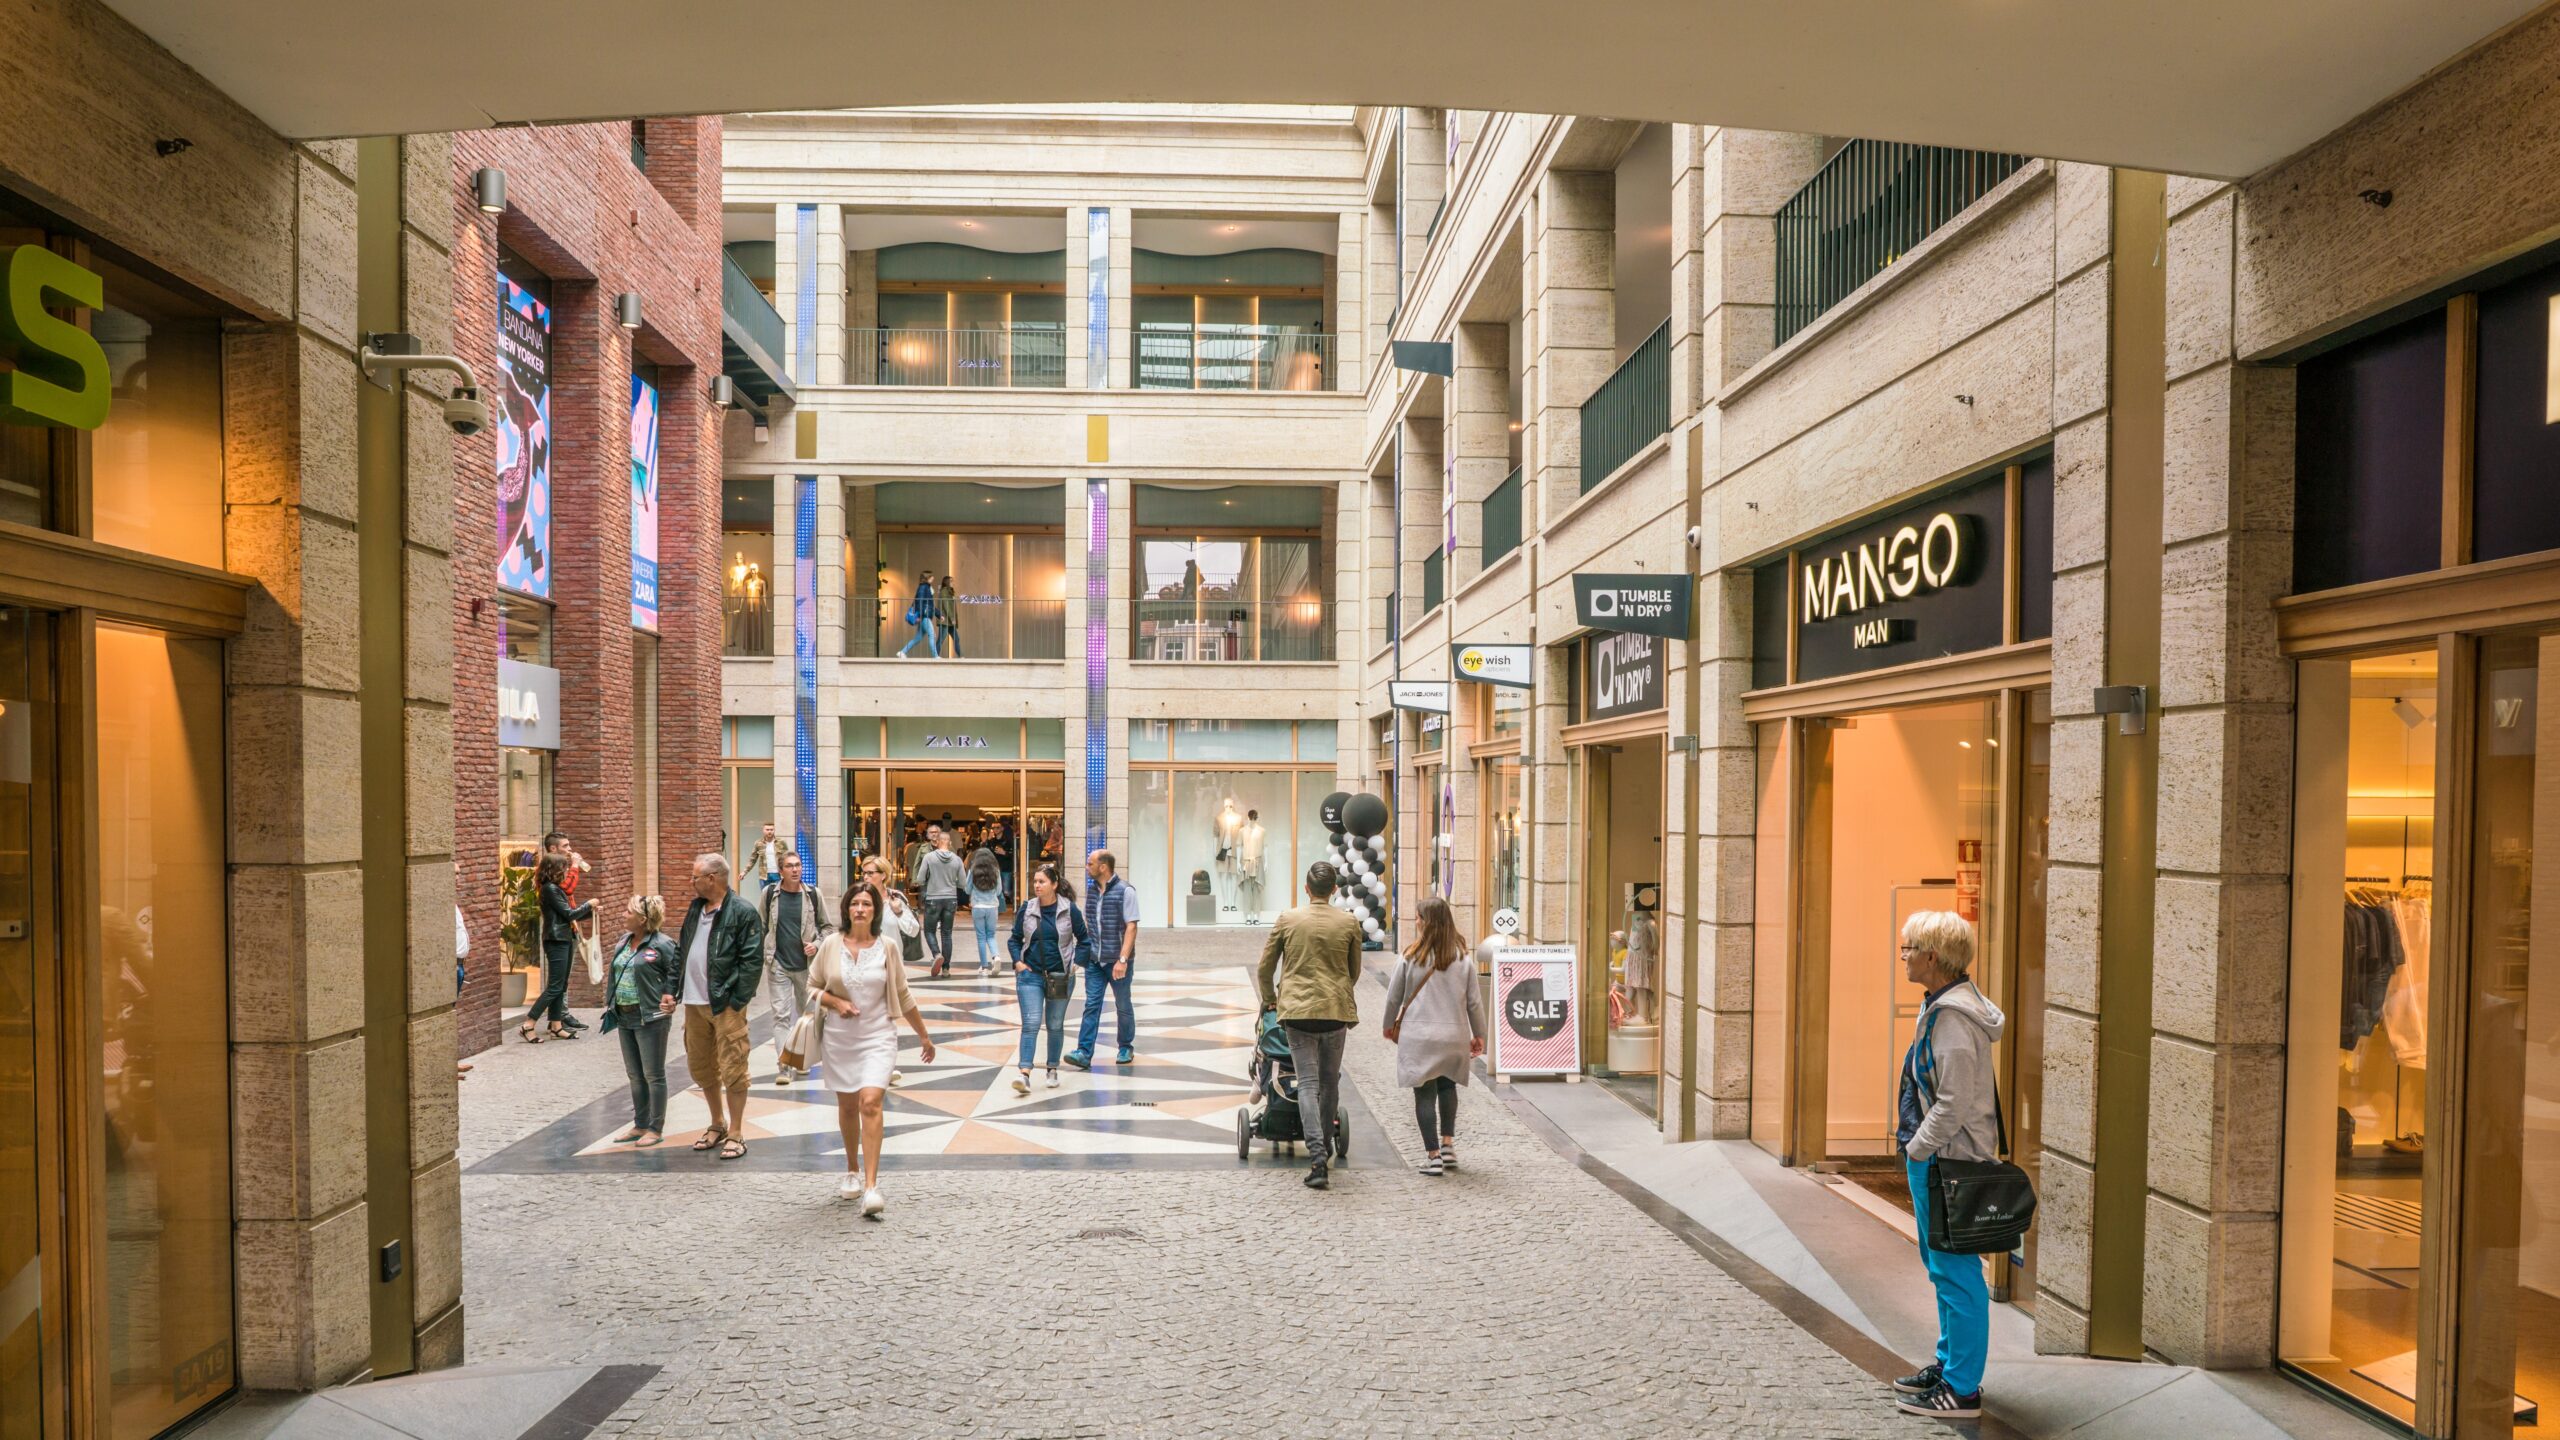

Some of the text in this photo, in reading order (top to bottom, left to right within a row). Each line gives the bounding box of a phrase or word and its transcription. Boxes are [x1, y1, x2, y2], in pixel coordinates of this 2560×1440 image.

[4, 243, 112, 431] S
[503, 309, 544, 353] BANDANA
[498, 331, 545, 376] NEW YORKER
[958, 359, 1001, 368] ZARA
[1804, 512, 1959, 625] MANGO
[635, 580, 655, 605] ZARA
[960, 594, 1003, 604] ZARA
[1619, 589, 1672, 603] TUMBLE
[1619, 604, 1634, 617] 'N
[1854, 617, 1888, 649] MAN
[1616, 632, 1652, 666] TUMBLE
[1463, 655, 1511, 668] eye wish
[925, 735, 989, 748] ZARA
[1512, 1000, 1561, 1019] SALE
